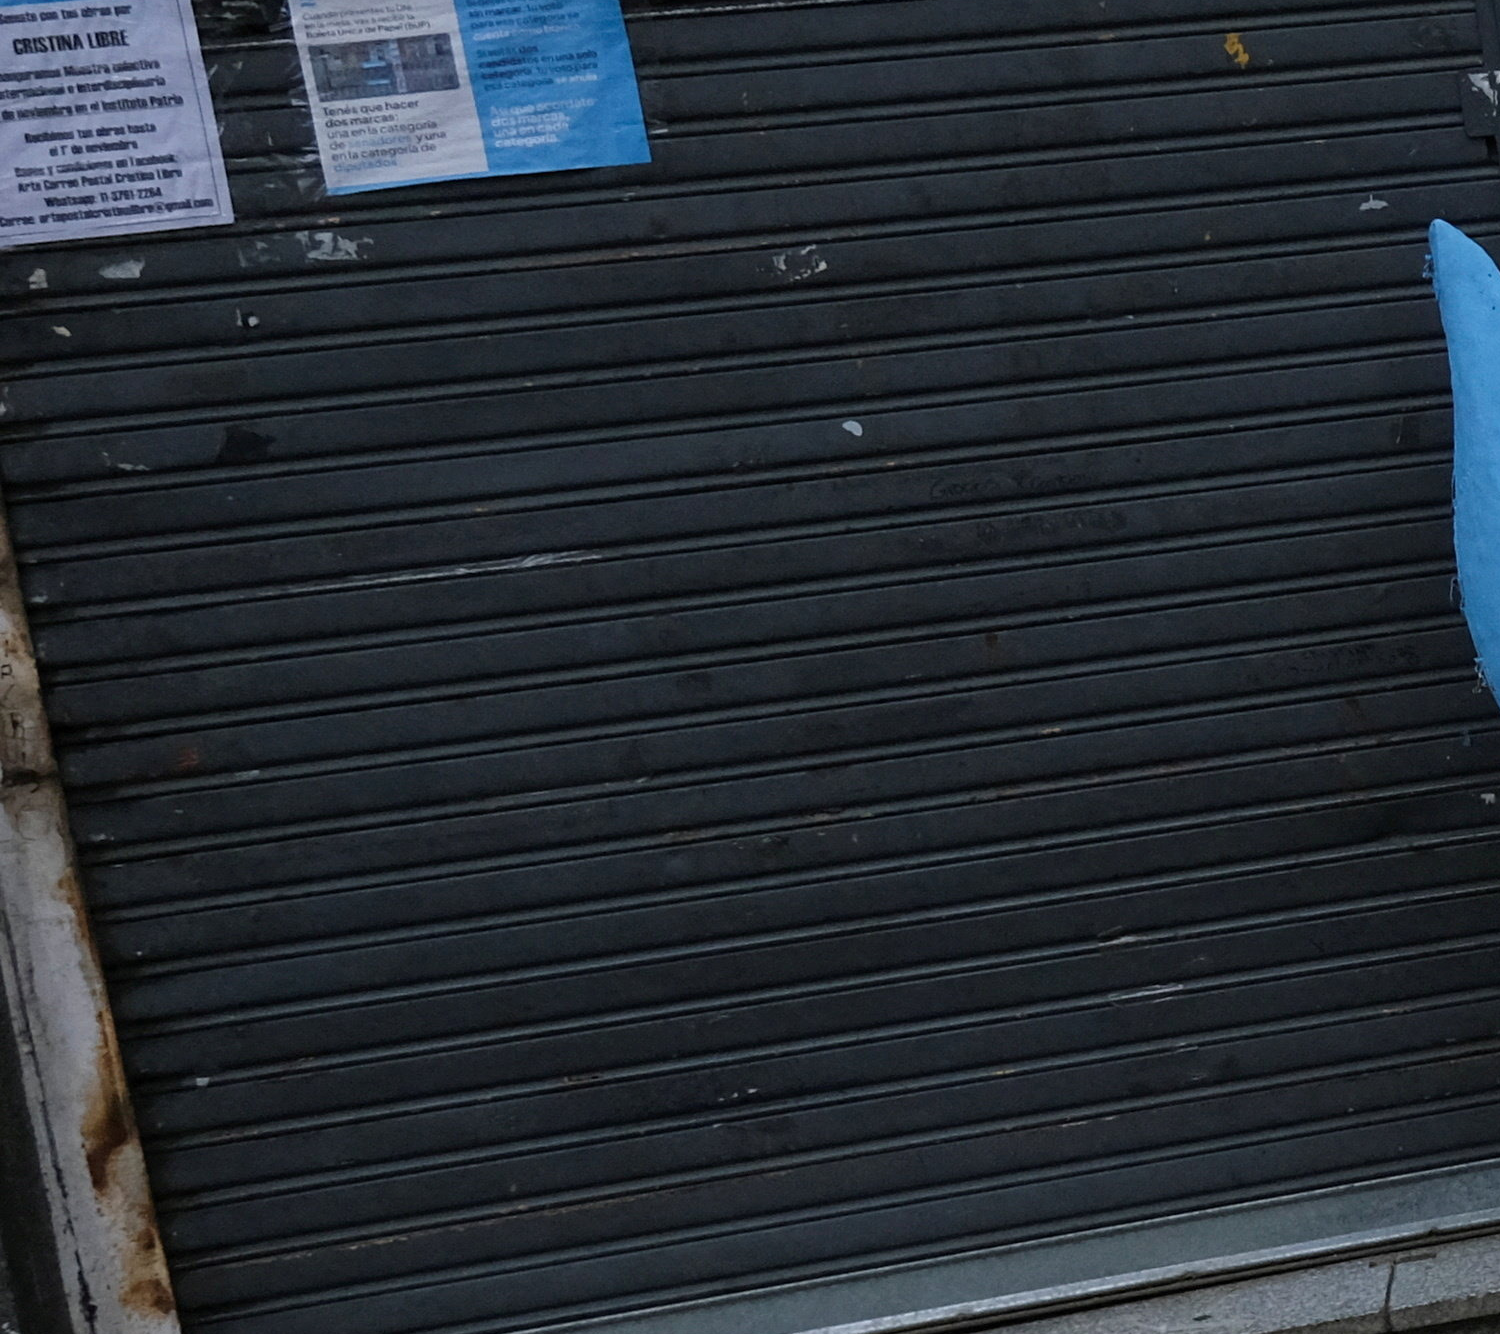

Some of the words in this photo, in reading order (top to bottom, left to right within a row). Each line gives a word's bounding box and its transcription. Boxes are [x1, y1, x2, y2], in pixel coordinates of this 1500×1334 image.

[12, 35, 85, 55] CRISTINA
[88, 30, 130, 49] LIBRE
[385, 99, 420, 111] hacer
